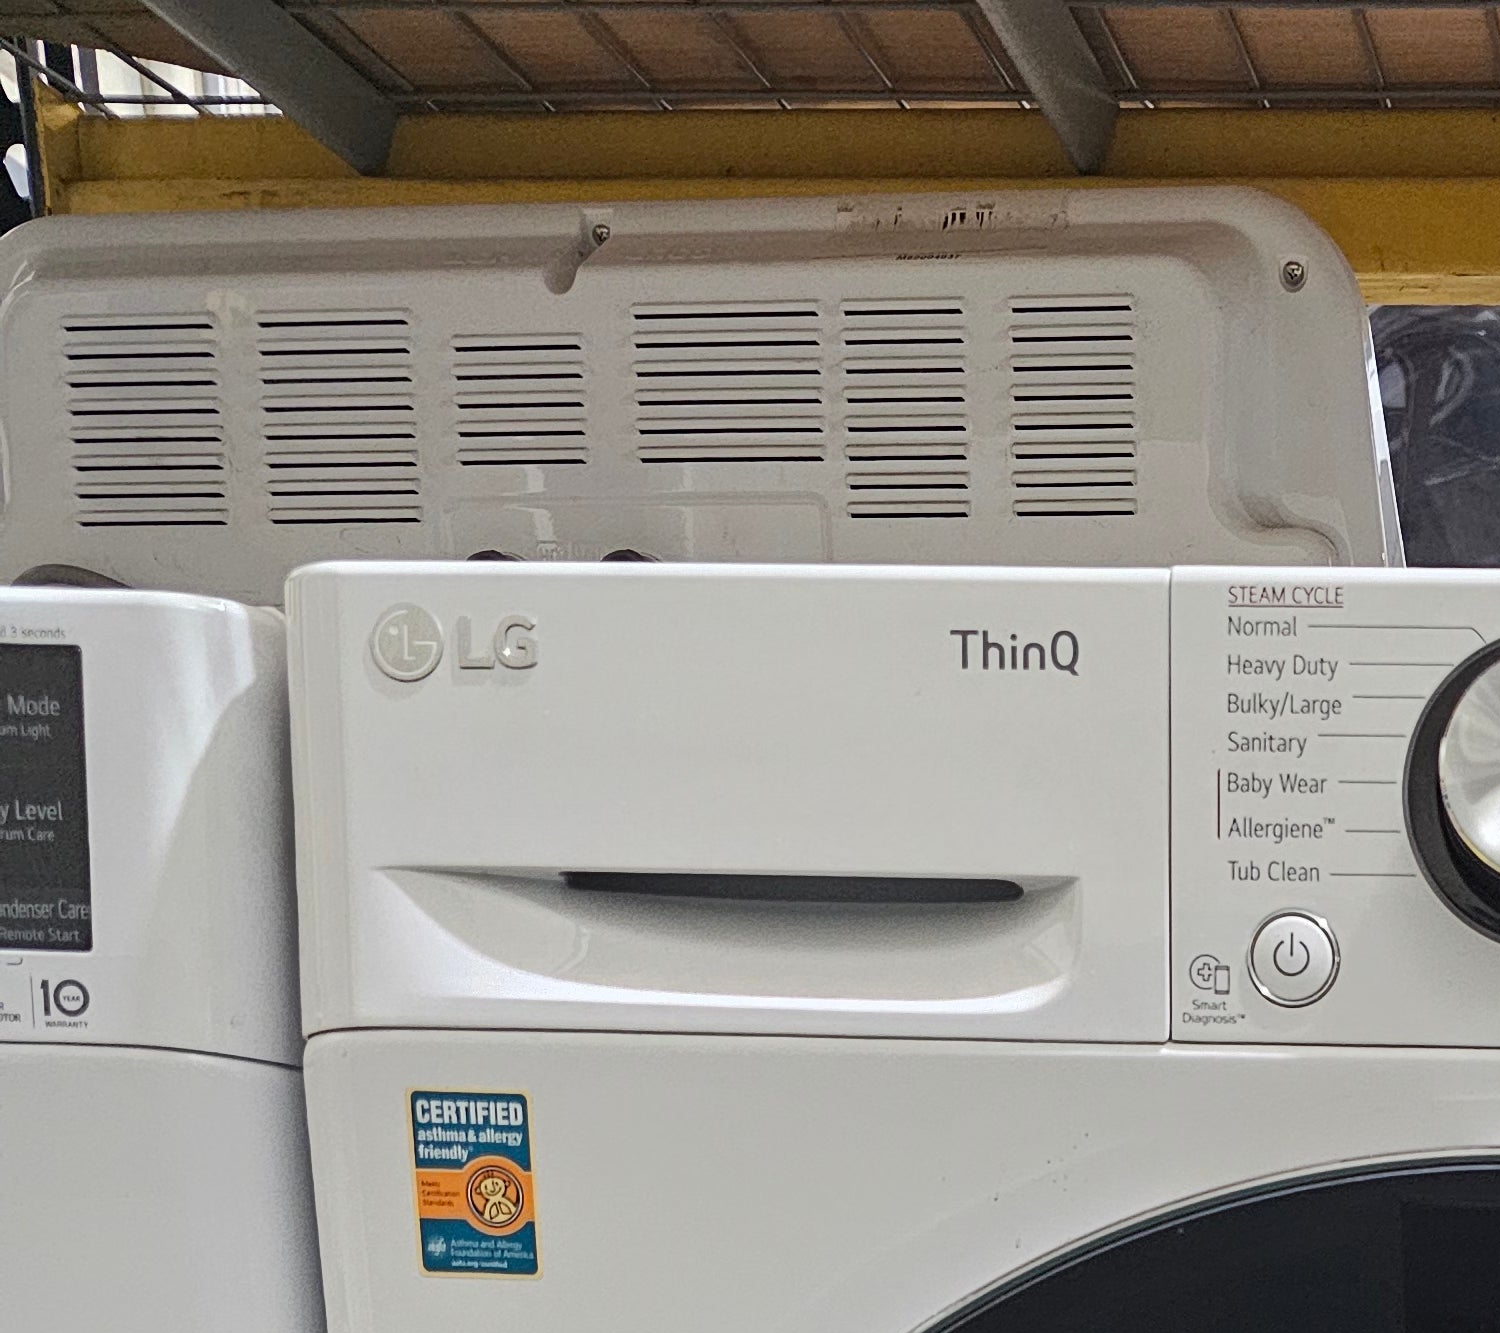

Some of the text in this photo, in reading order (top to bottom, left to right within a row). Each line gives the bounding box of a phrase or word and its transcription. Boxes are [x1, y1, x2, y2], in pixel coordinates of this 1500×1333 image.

[1227, 585, 1345, 606] STEAM CYCLE
[1227, 616, 1298, 637] Normal
[455, 613, 540, 671] LG
[949, 629, 1080, 676] ThinQ
[1227, 654, 1339, 682] Heavy Duty
[6, 693, 61, 717] Mode
[1227, 691, 1343, 721] Bulky/Large
[1227, 731, 1308, 759] Sanitary
[1227, 771, 1329, 799] Baby Wear
[14, 799, 64, 821] Level
[1227, 860, 1320, 883] Tub Clean
[58, 898, 90, 921] Care
[47, 927, 80, 943] Start
[40, 979, 91, 1017] 10
[1191, 998, 1228, 1012] Smart
[415, 1099, 524, 1127] CERTIFIED
[417, 1126, 523, 1147] asthma & allergy
